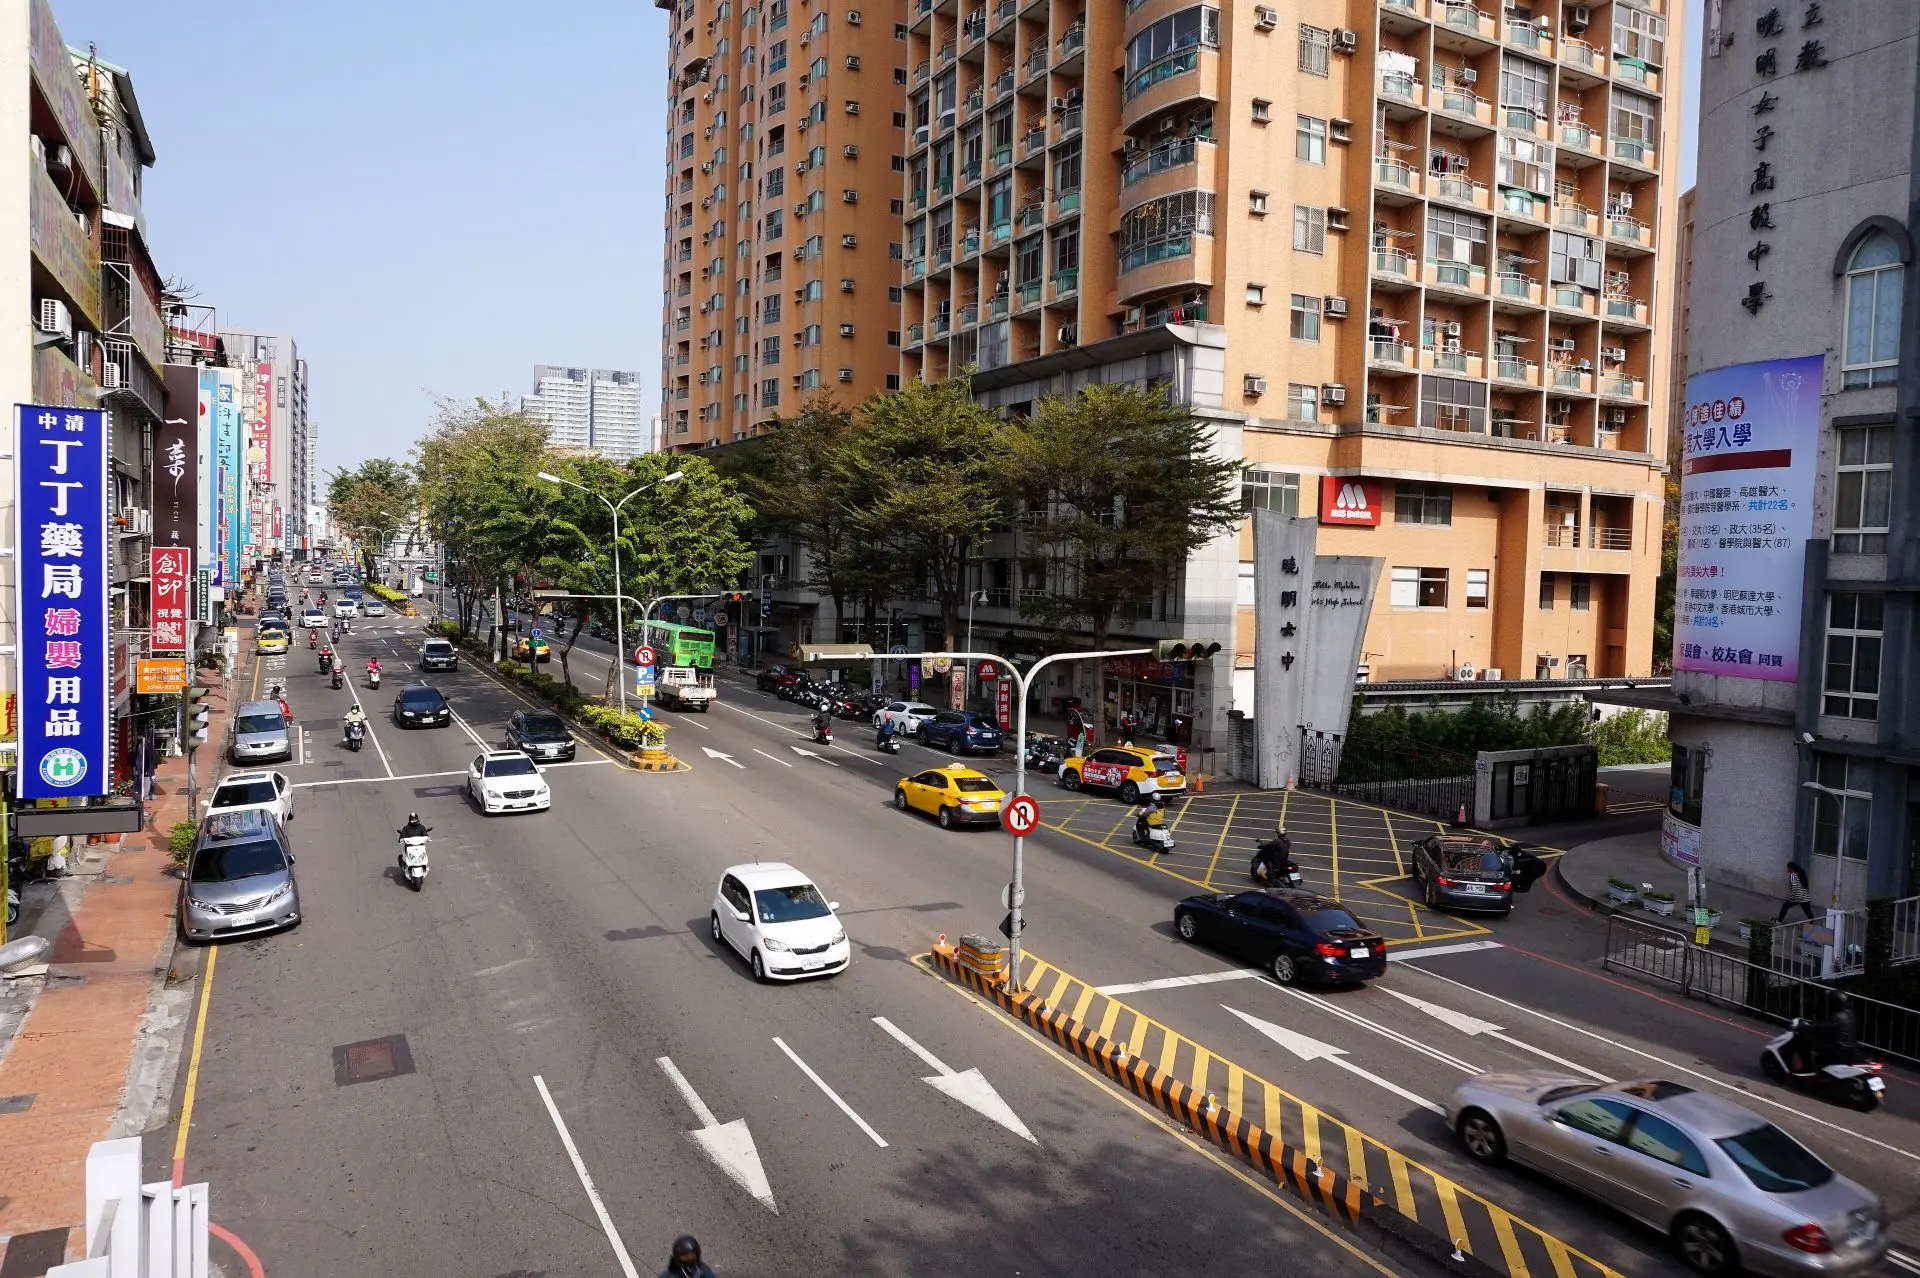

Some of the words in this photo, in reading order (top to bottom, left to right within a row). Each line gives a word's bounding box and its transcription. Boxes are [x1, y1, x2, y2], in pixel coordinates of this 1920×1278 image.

[38, 413, 85, 432] 中清
[39, 440, 84, 599] 丁丁藥局
[45, 608, 82, 737] 婦嬰用品
